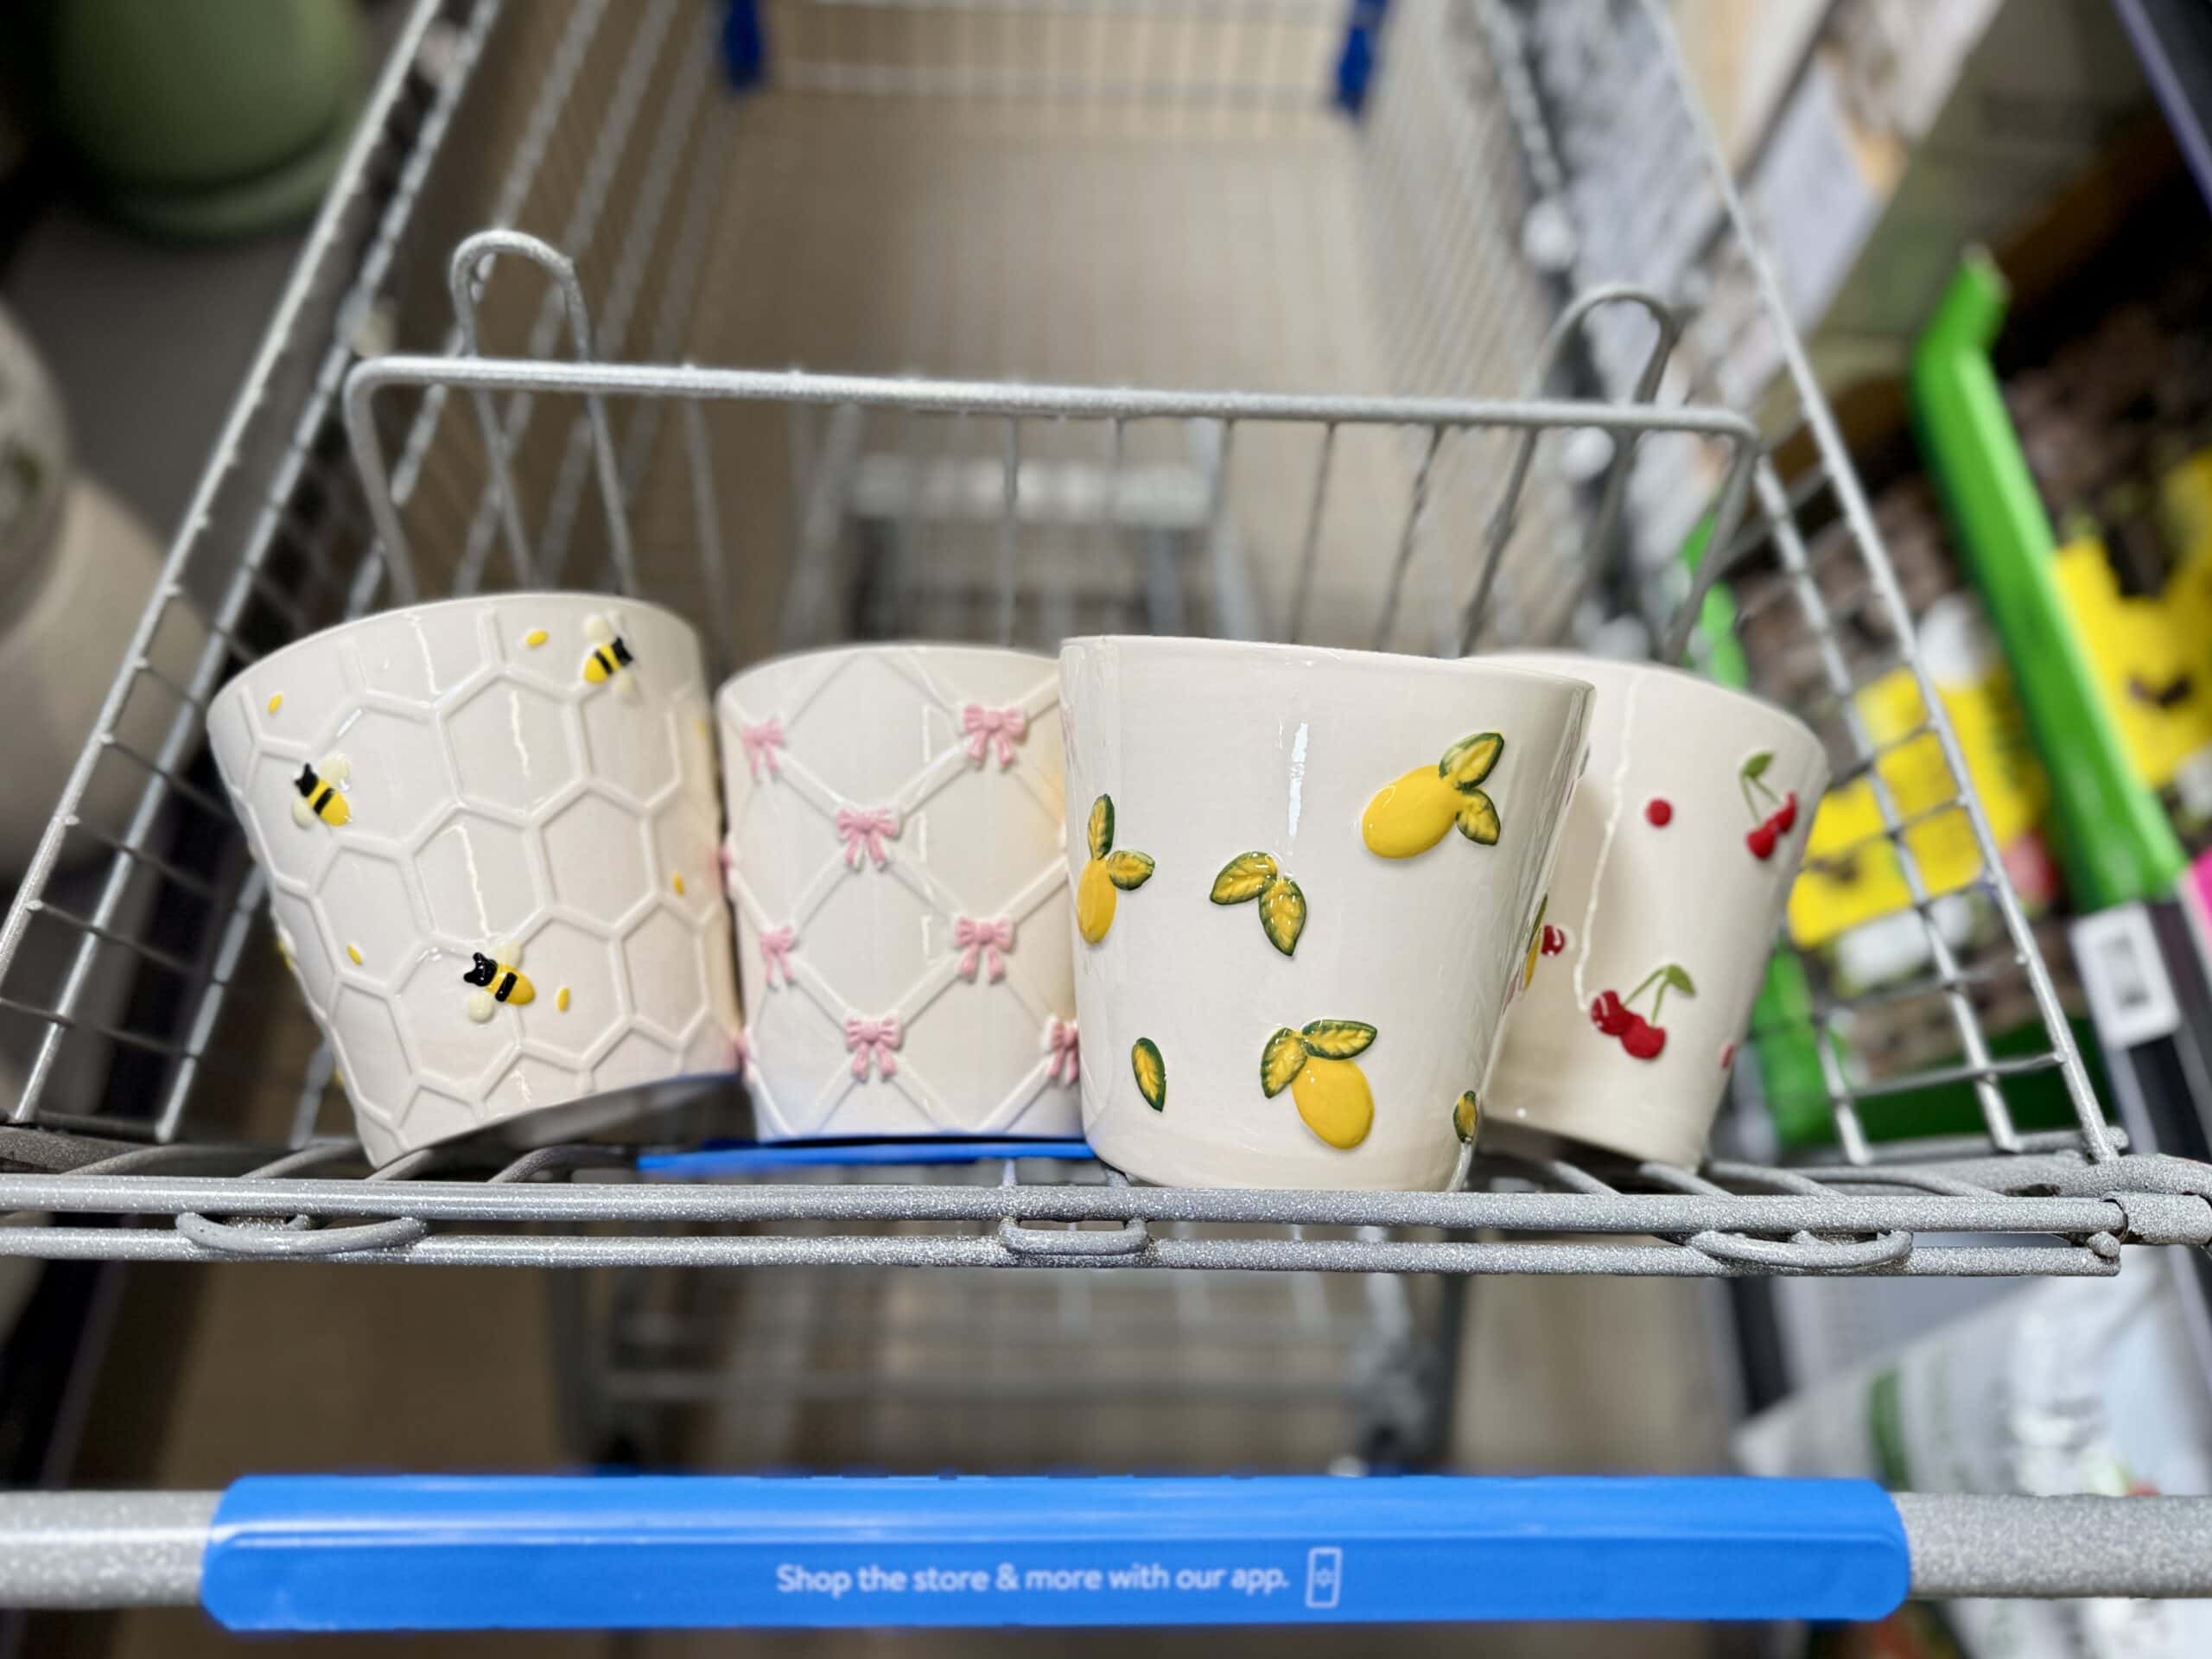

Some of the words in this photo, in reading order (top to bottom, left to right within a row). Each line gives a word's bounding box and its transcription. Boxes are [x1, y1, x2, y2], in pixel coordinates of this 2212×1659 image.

[776, 1563, 851, 1598] Shop
[858, 1565, 906, 1591] the
[913, 1567, 988, 1591] store
[995, 1563, 1018, 1590] &
[1026, 1569, 1102, 1589] more
[1109, 1565, 1168, 1588] with
[1176, 1569, 1225, 1589] our
[1230, 1568, 1290, 1595] app.
